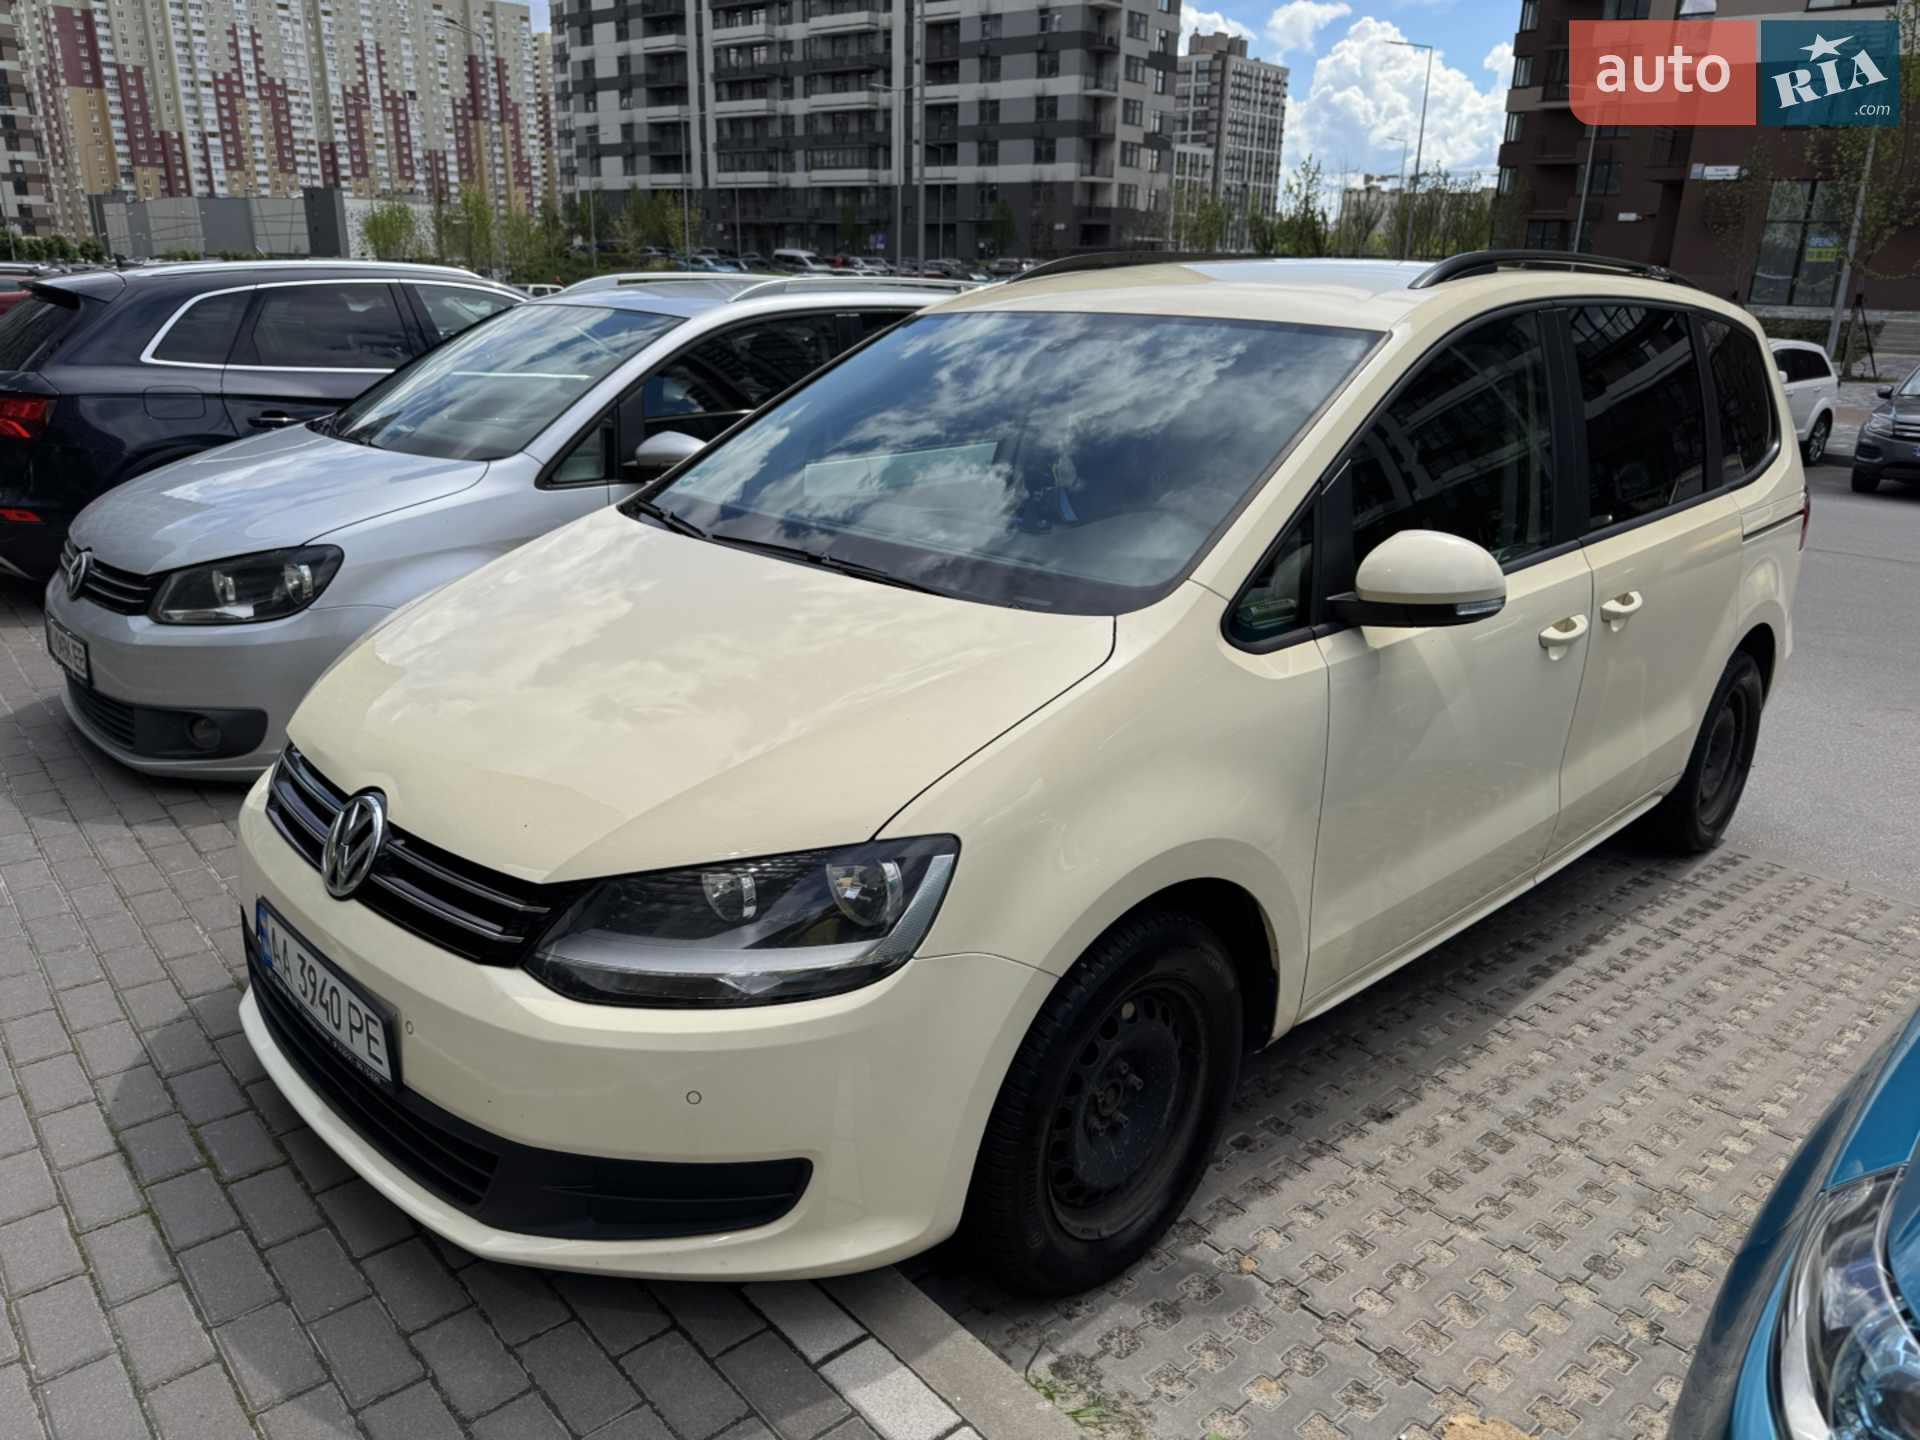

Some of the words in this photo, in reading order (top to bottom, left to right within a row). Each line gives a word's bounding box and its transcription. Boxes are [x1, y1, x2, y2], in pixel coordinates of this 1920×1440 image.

[271, 926, 294, 985] AA
[297, 952, 342, 1032] 3940
[348, 998, 384, 1067] PE
